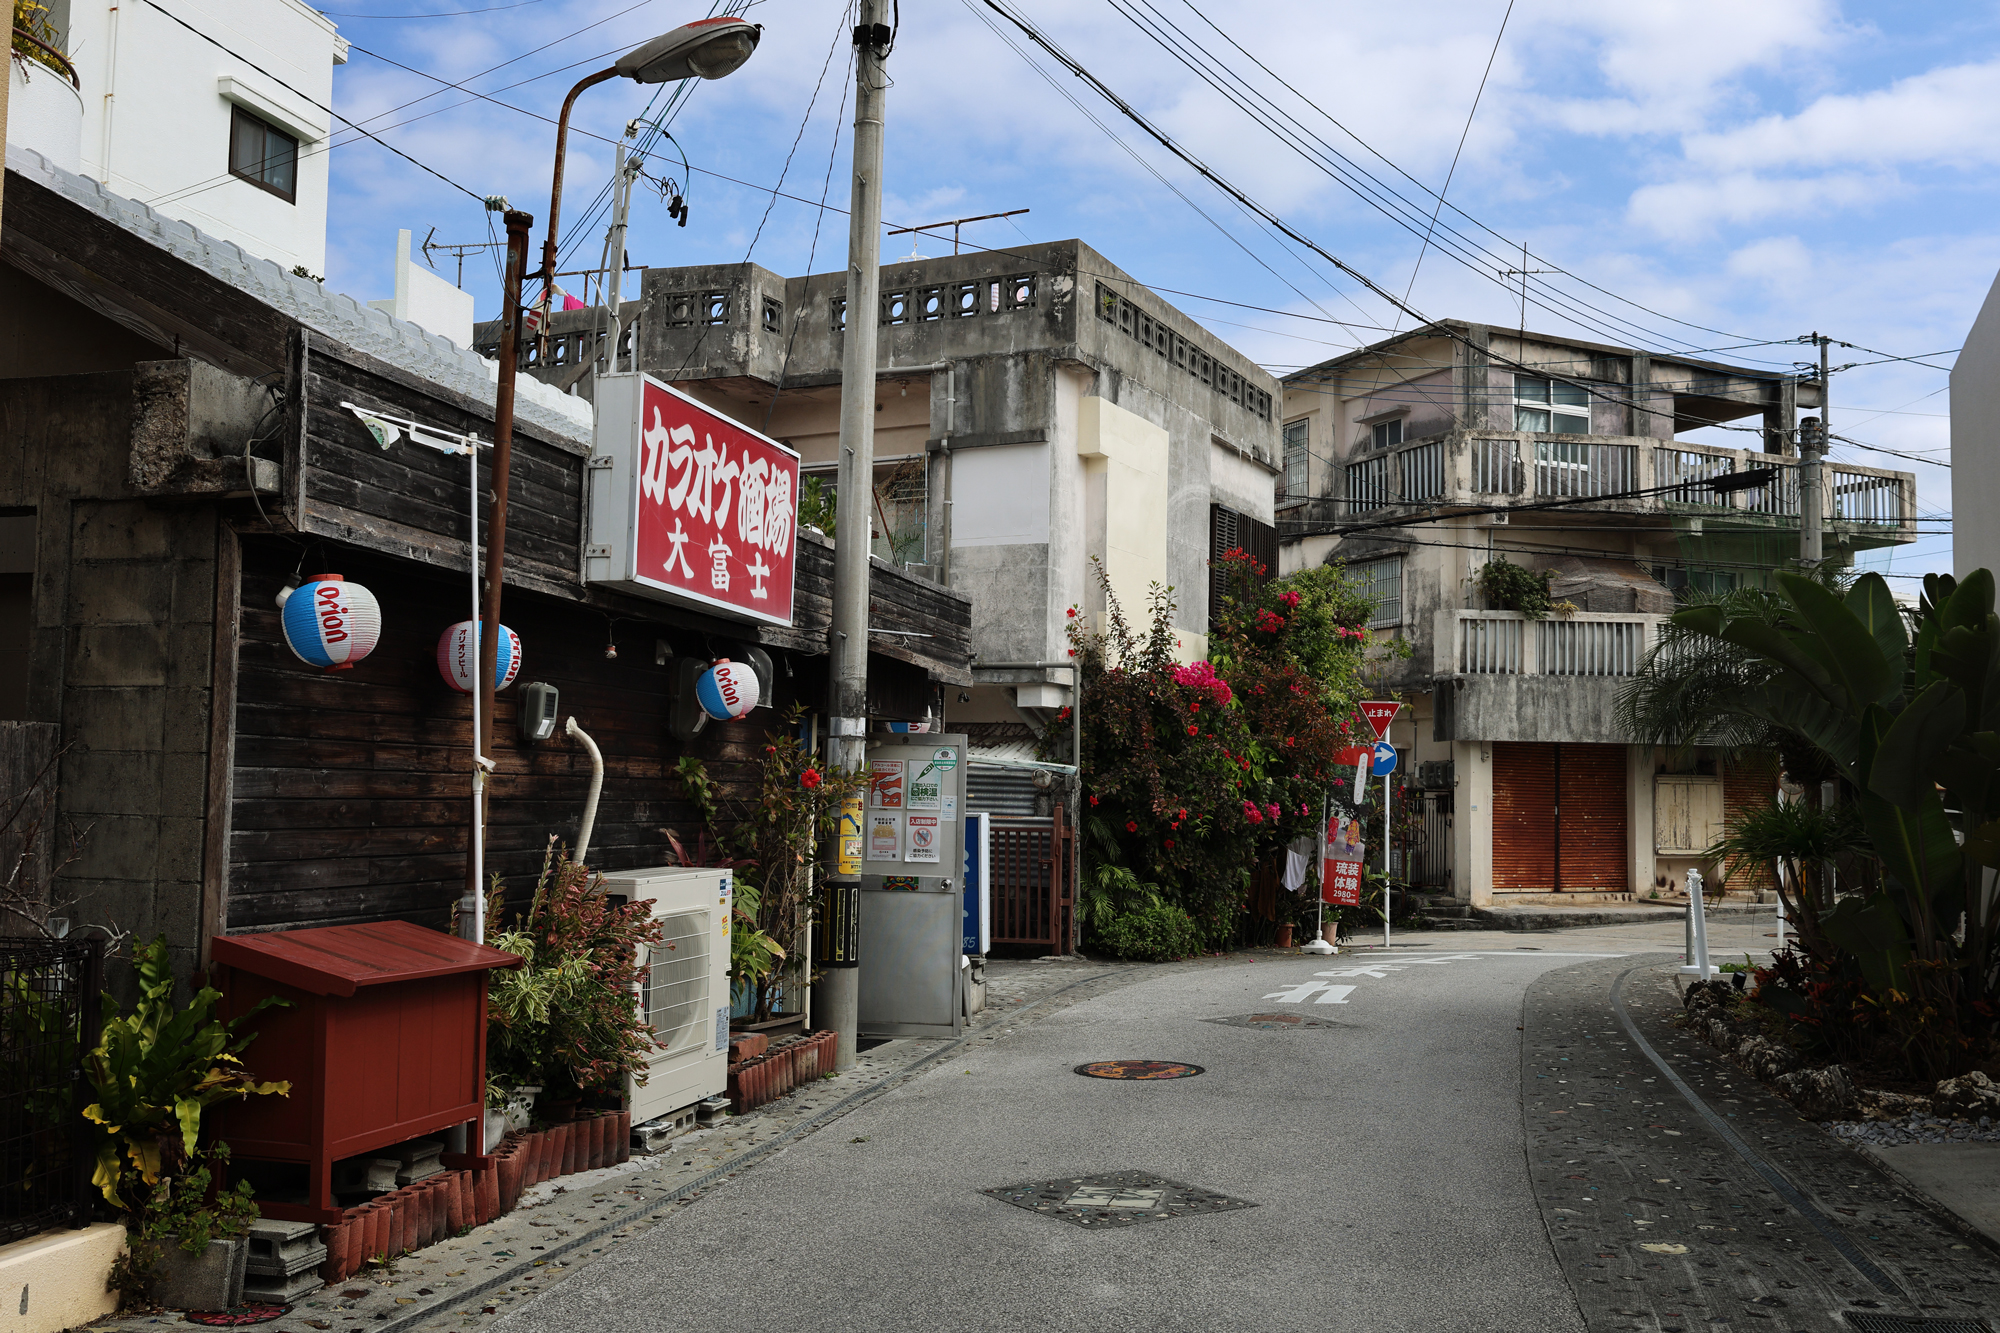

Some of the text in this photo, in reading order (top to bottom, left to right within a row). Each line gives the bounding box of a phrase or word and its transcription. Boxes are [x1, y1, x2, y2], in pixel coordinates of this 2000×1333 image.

[642, 406, 794, 558] カラオケ酒場
[663, 517, 770, 600] 大富士
[317, 587, 349, 644] orion
[458, 629, 468, 678] オリオンビール
[504, 633, 521, 682] orion
[716, 667, 740, 706] orion
[1367, 708, 1393, 718] 止まれ
[1334, 876, 1359, 891] 体験
[1335, 862, 1360, 876] 琉装
